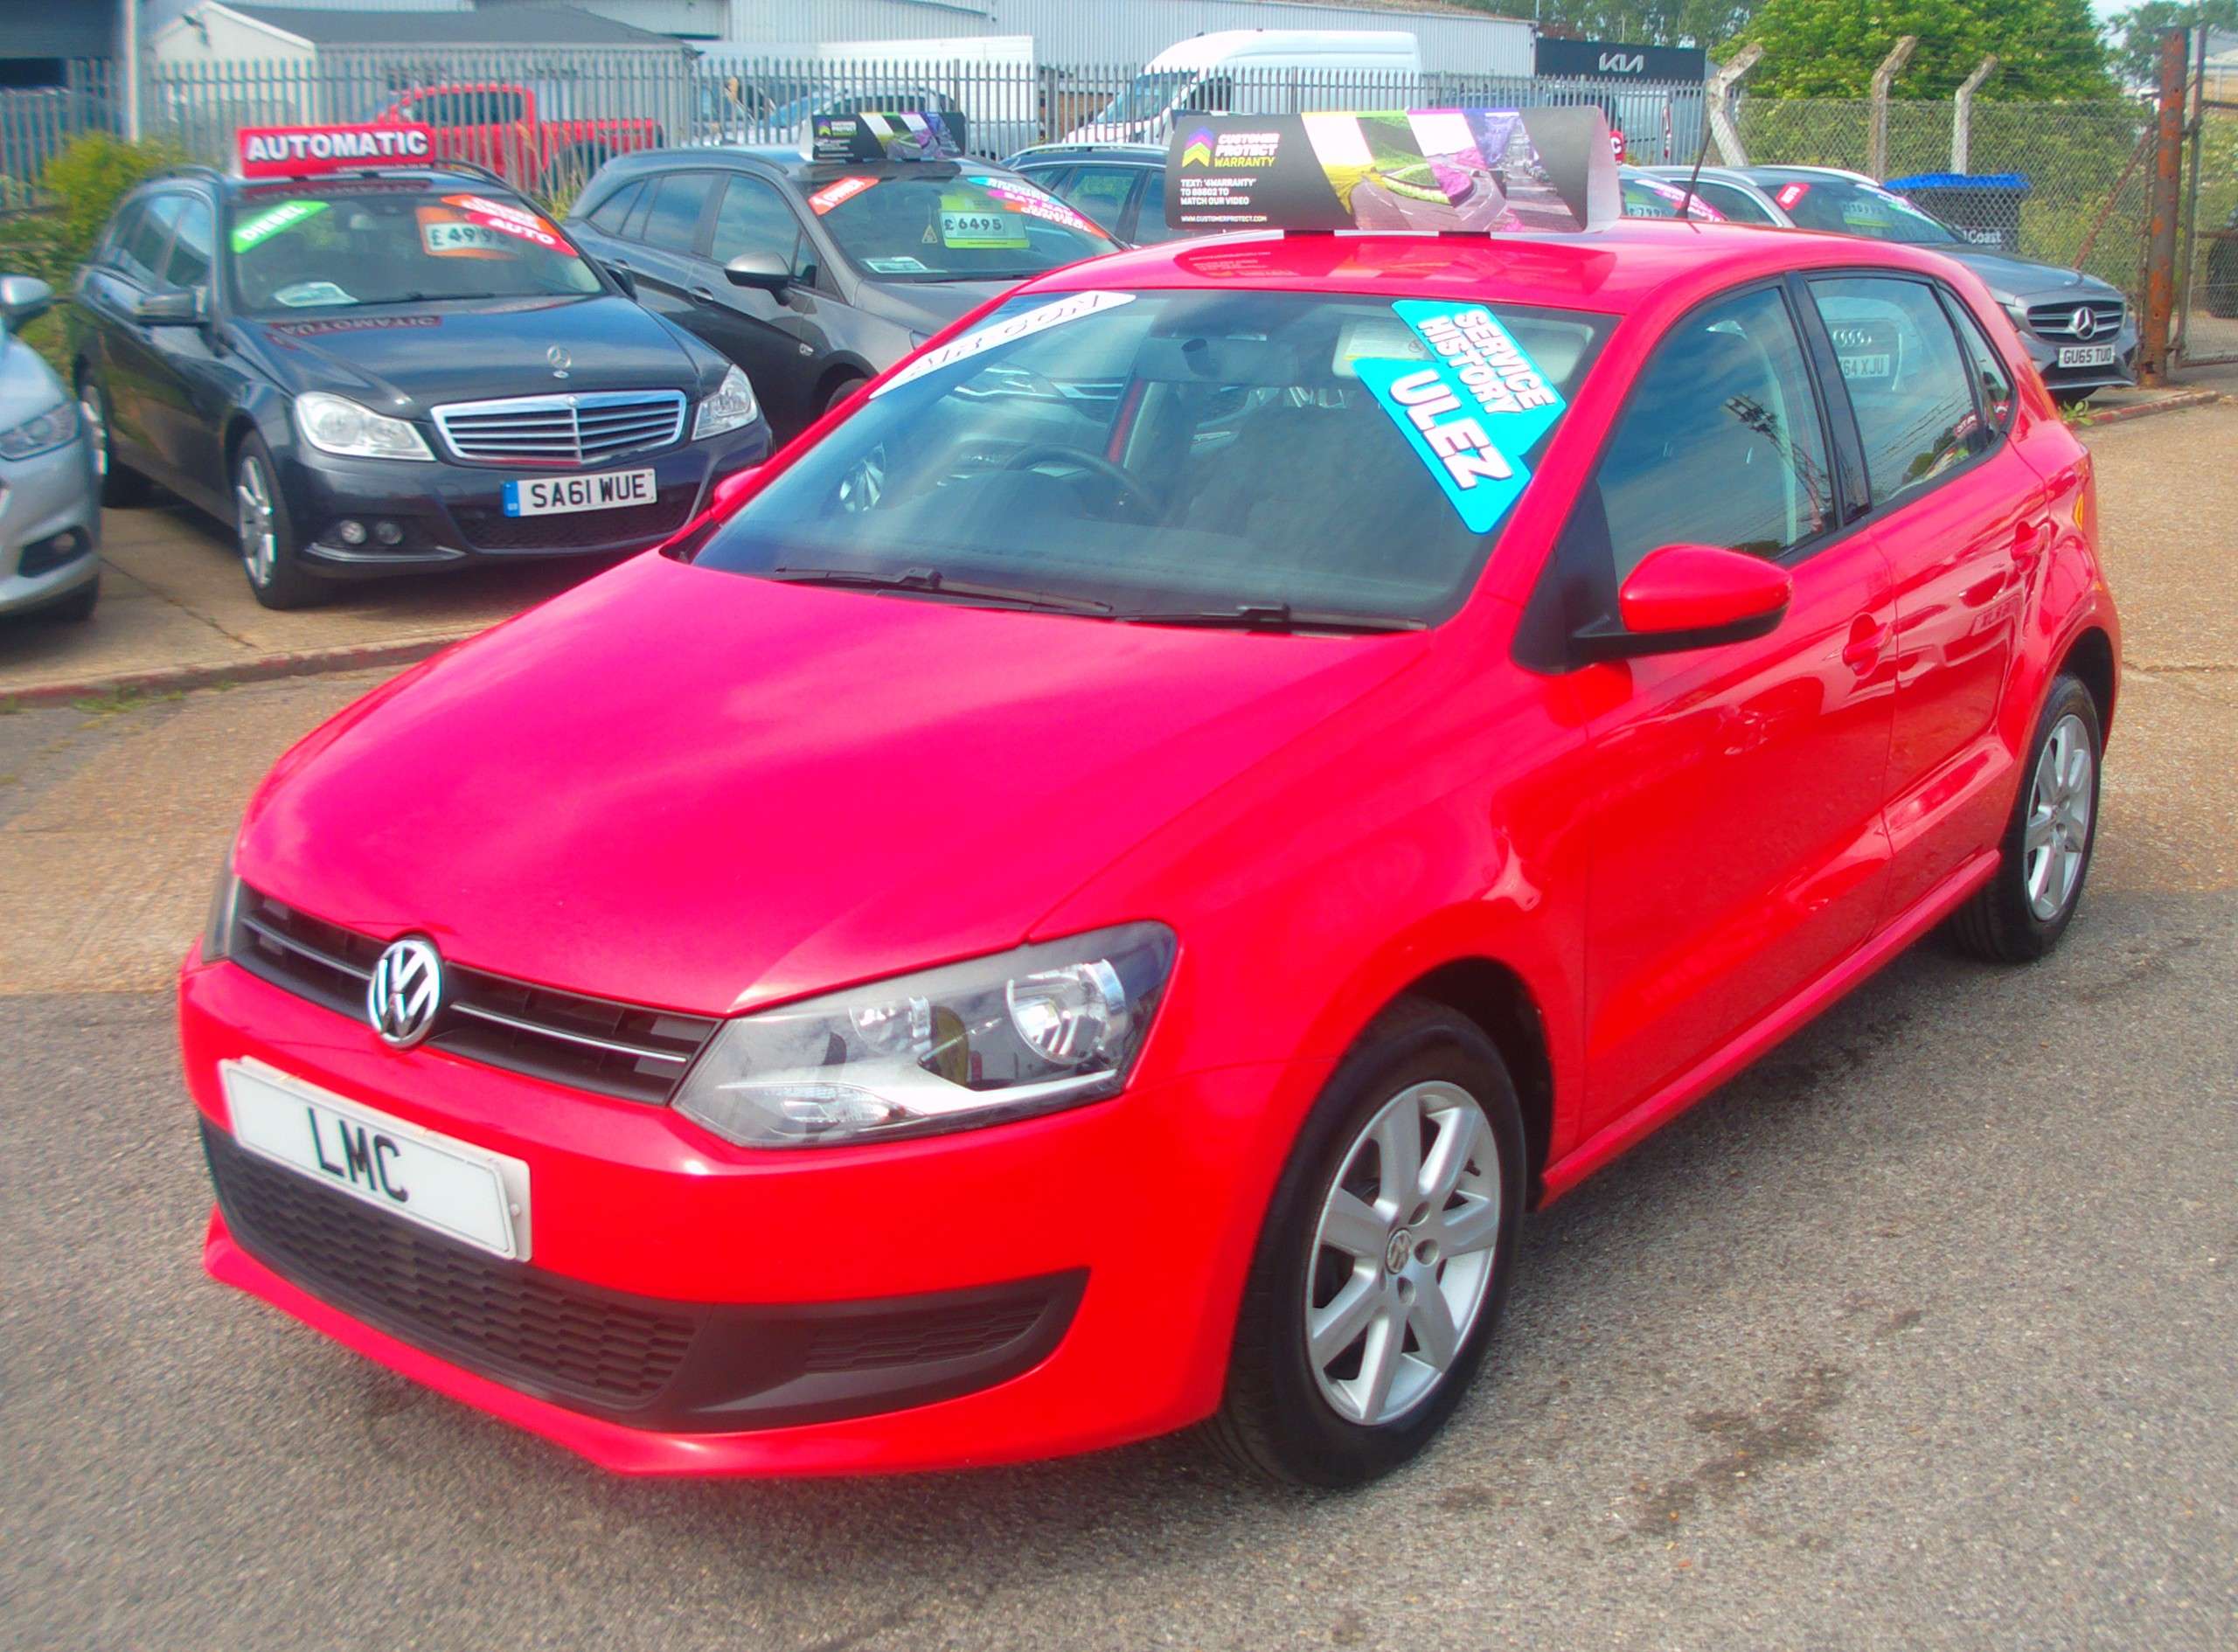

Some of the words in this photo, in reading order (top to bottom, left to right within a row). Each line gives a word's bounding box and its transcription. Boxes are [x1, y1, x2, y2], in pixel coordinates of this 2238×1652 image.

[246, 130, 429, 161] AUTOMATIC
[1215, 143, 1278, 156] PROTECT
[1218, 133, 1280, 144] CUSTOMER
[1213, 156, 1276, 168] WARRANTY
[1226, 196, 1250, 205] VIDEO
[486, 218, 557, 246] AUTO
[1416, 316, 1523, 413] HISTORY
[1452, 309, 1556, 410] SERVICE
[2063, 349, 2093, 364] GU65
[1389, 368, 1514, 490] ULEZ
[531, 479, 591, 508] SA61
[600, 473, 646, 503] WUE
[306, 1106, 409, 1203] LMC
